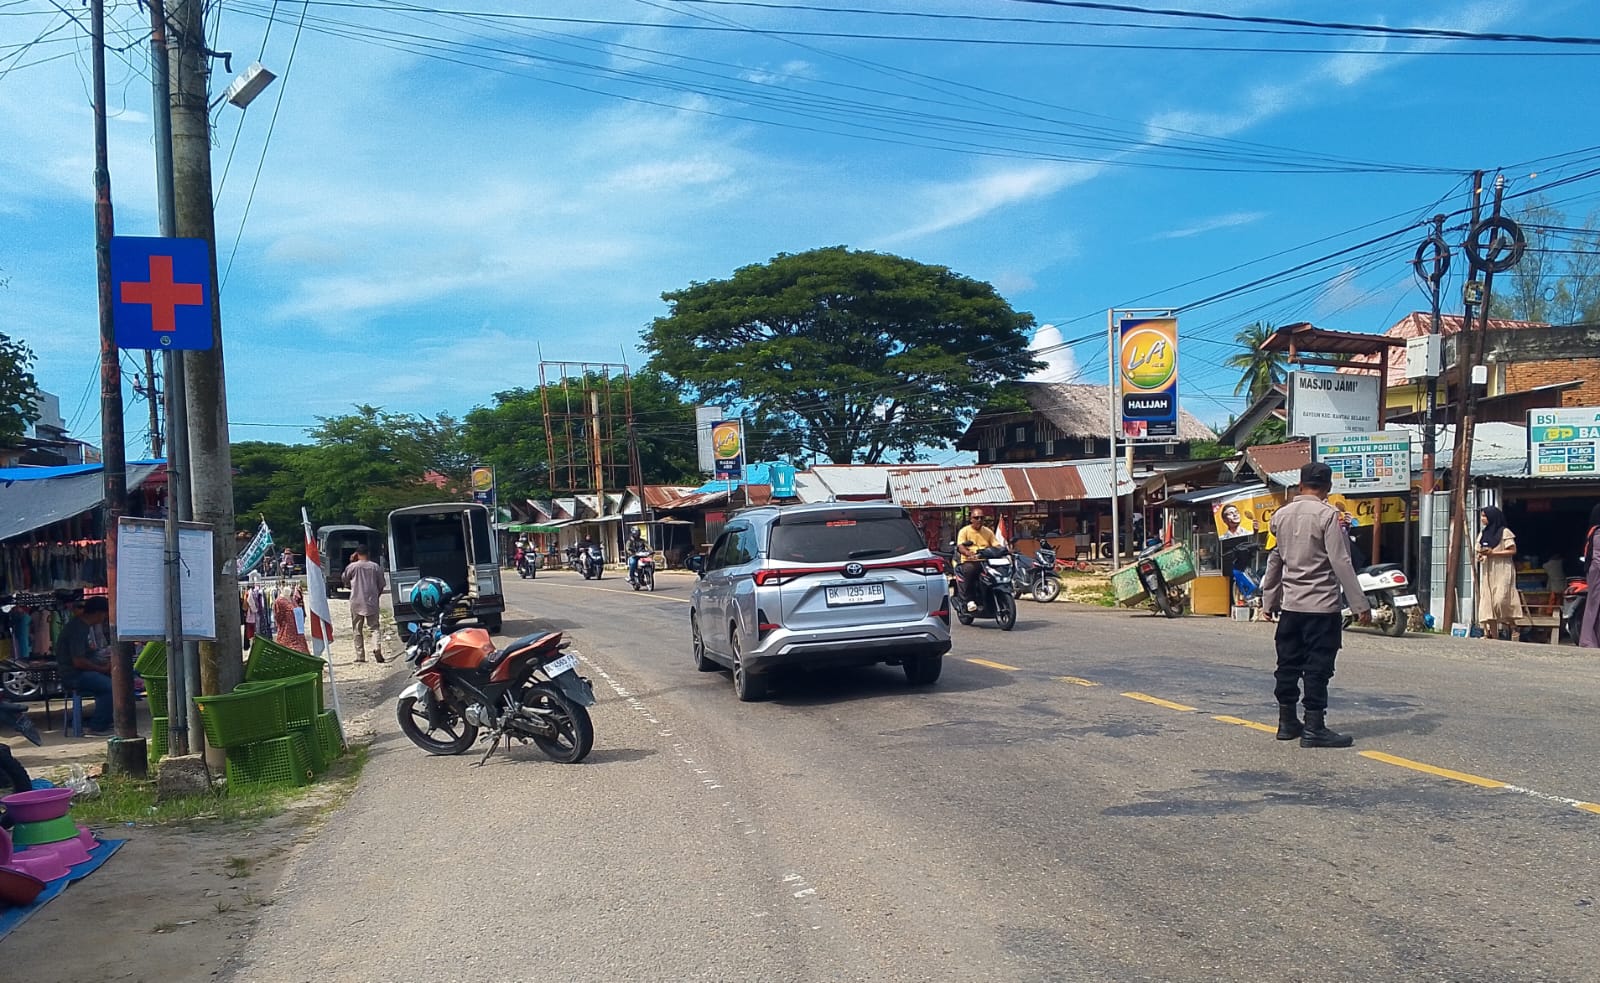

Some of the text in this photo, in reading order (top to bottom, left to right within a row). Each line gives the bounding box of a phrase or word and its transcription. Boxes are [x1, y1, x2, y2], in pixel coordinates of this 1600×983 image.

[1300, 377, 1358, 392] MASJID JAMI'
[1128, 400, 1167, 409] HALIJAH
[1537, 415, 1556, 424] BSI
[1373, 443, 1400, 451] PONSEL
[829, 588, 839, 598] BK
[846, 586, 864, 597] 1295
